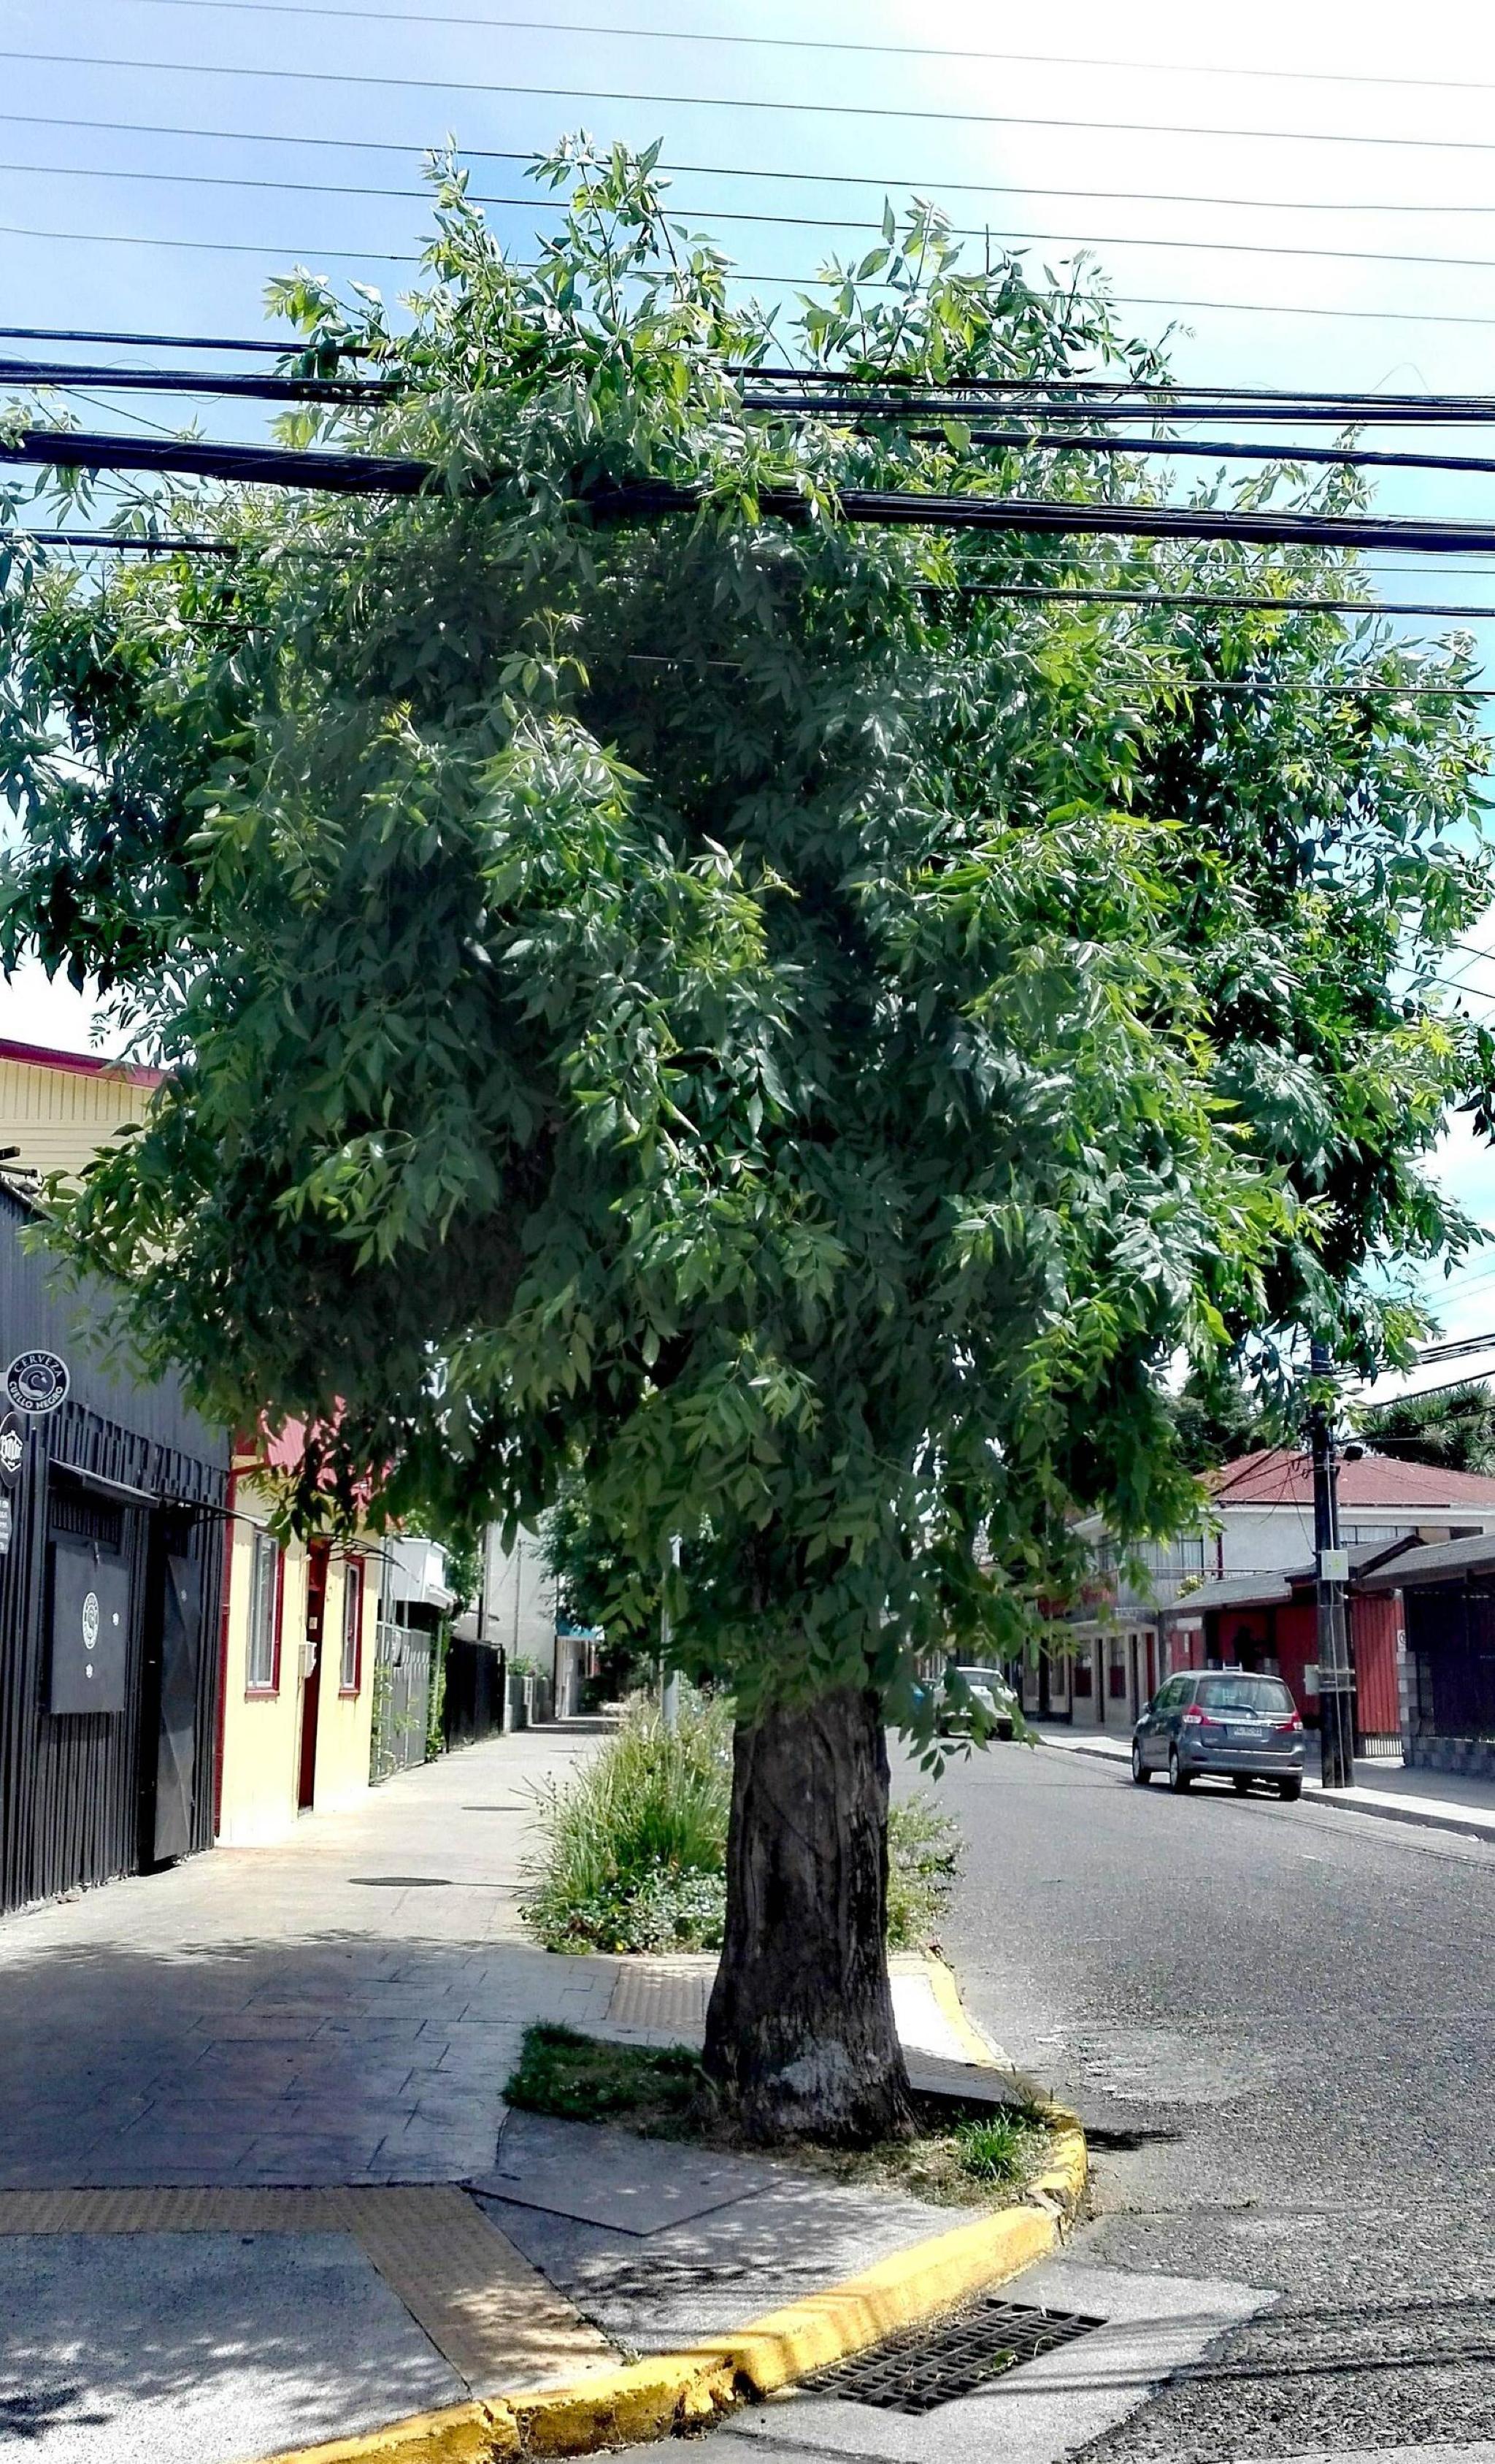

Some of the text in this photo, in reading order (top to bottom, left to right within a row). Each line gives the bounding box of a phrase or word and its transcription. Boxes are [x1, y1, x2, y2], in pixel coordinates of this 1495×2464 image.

[15, 1355, 63, 1378] CERVEZA
[9, 1381, 64, 1410] CUELLO NEGRO
